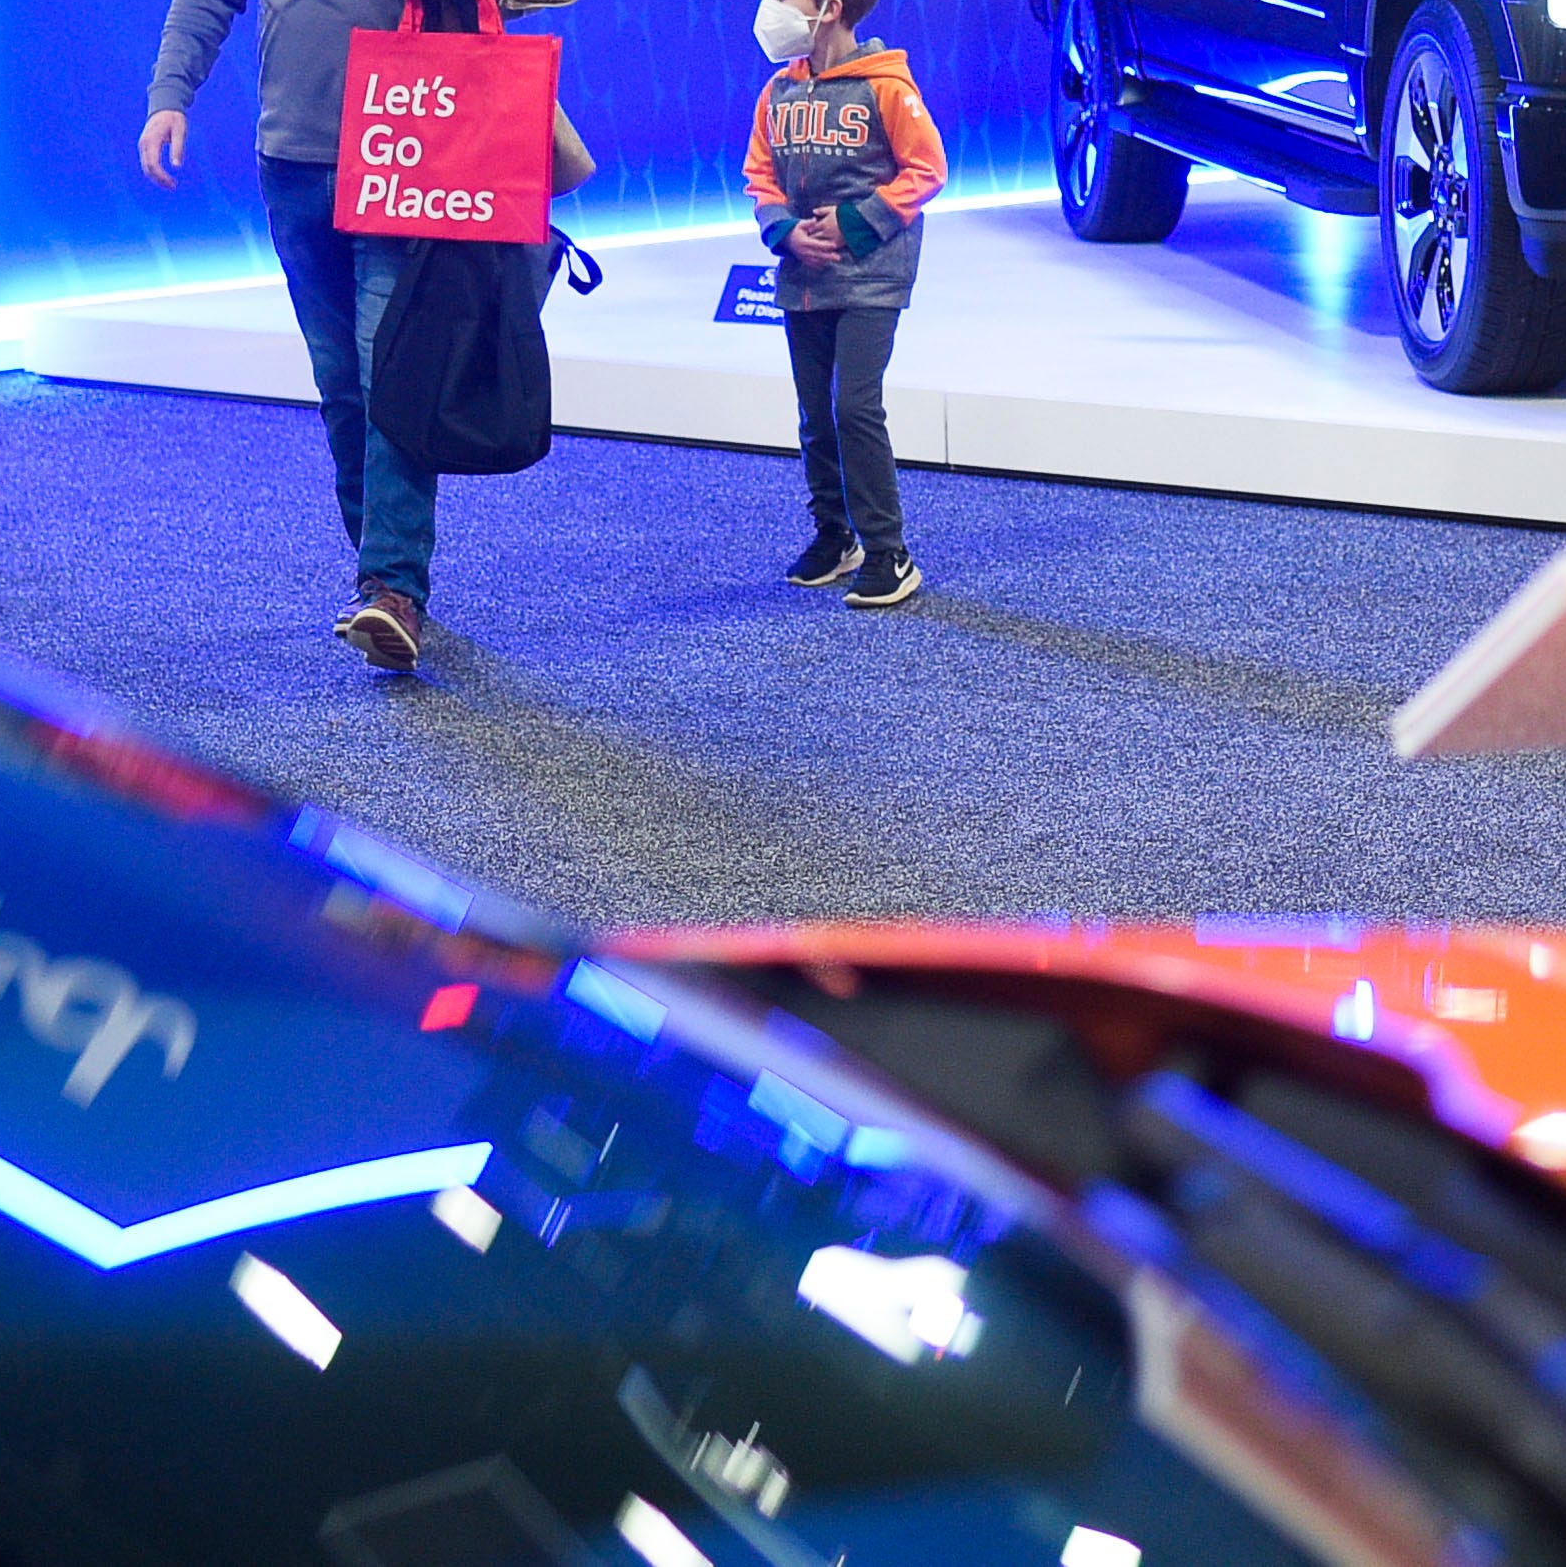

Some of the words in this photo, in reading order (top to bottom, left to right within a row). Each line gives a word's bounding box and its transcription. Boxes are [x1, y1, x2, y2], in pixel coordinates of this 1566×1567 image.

[362, 73, 457, 118] Let's
[360, 124, 423, 167] Go
[355, 174, 495, 222] Places
